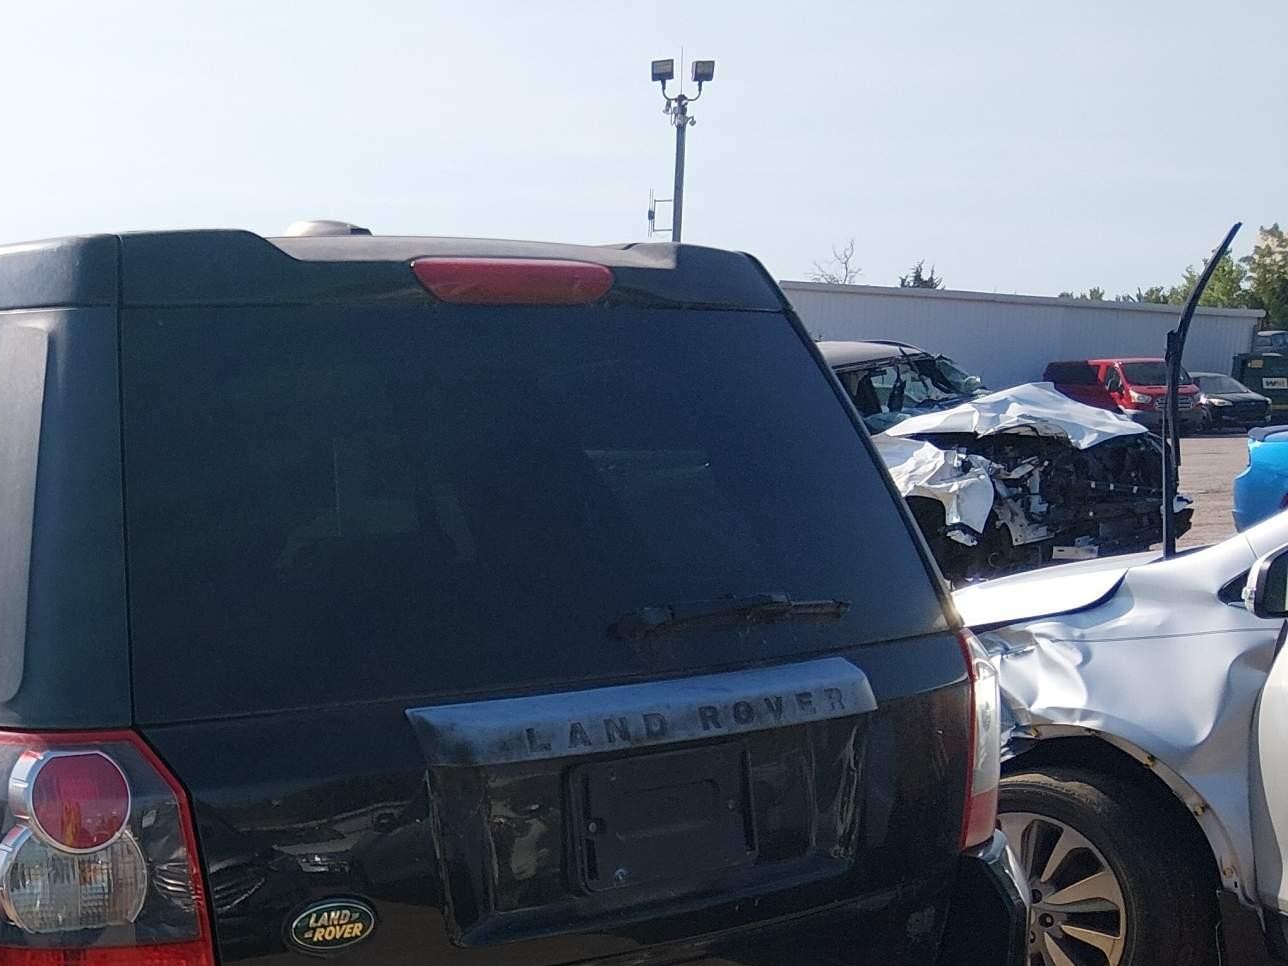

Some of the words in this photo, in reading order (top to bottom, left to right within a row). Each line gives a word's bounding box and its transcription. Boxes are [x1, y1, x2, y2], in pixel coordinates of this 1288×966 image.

[524, 713, 669, 754] LAND
[698, 686, 847, 732] ROVER
[309, 910, 351, 927] LAND
[313, 921, 363, 942] ROVER
